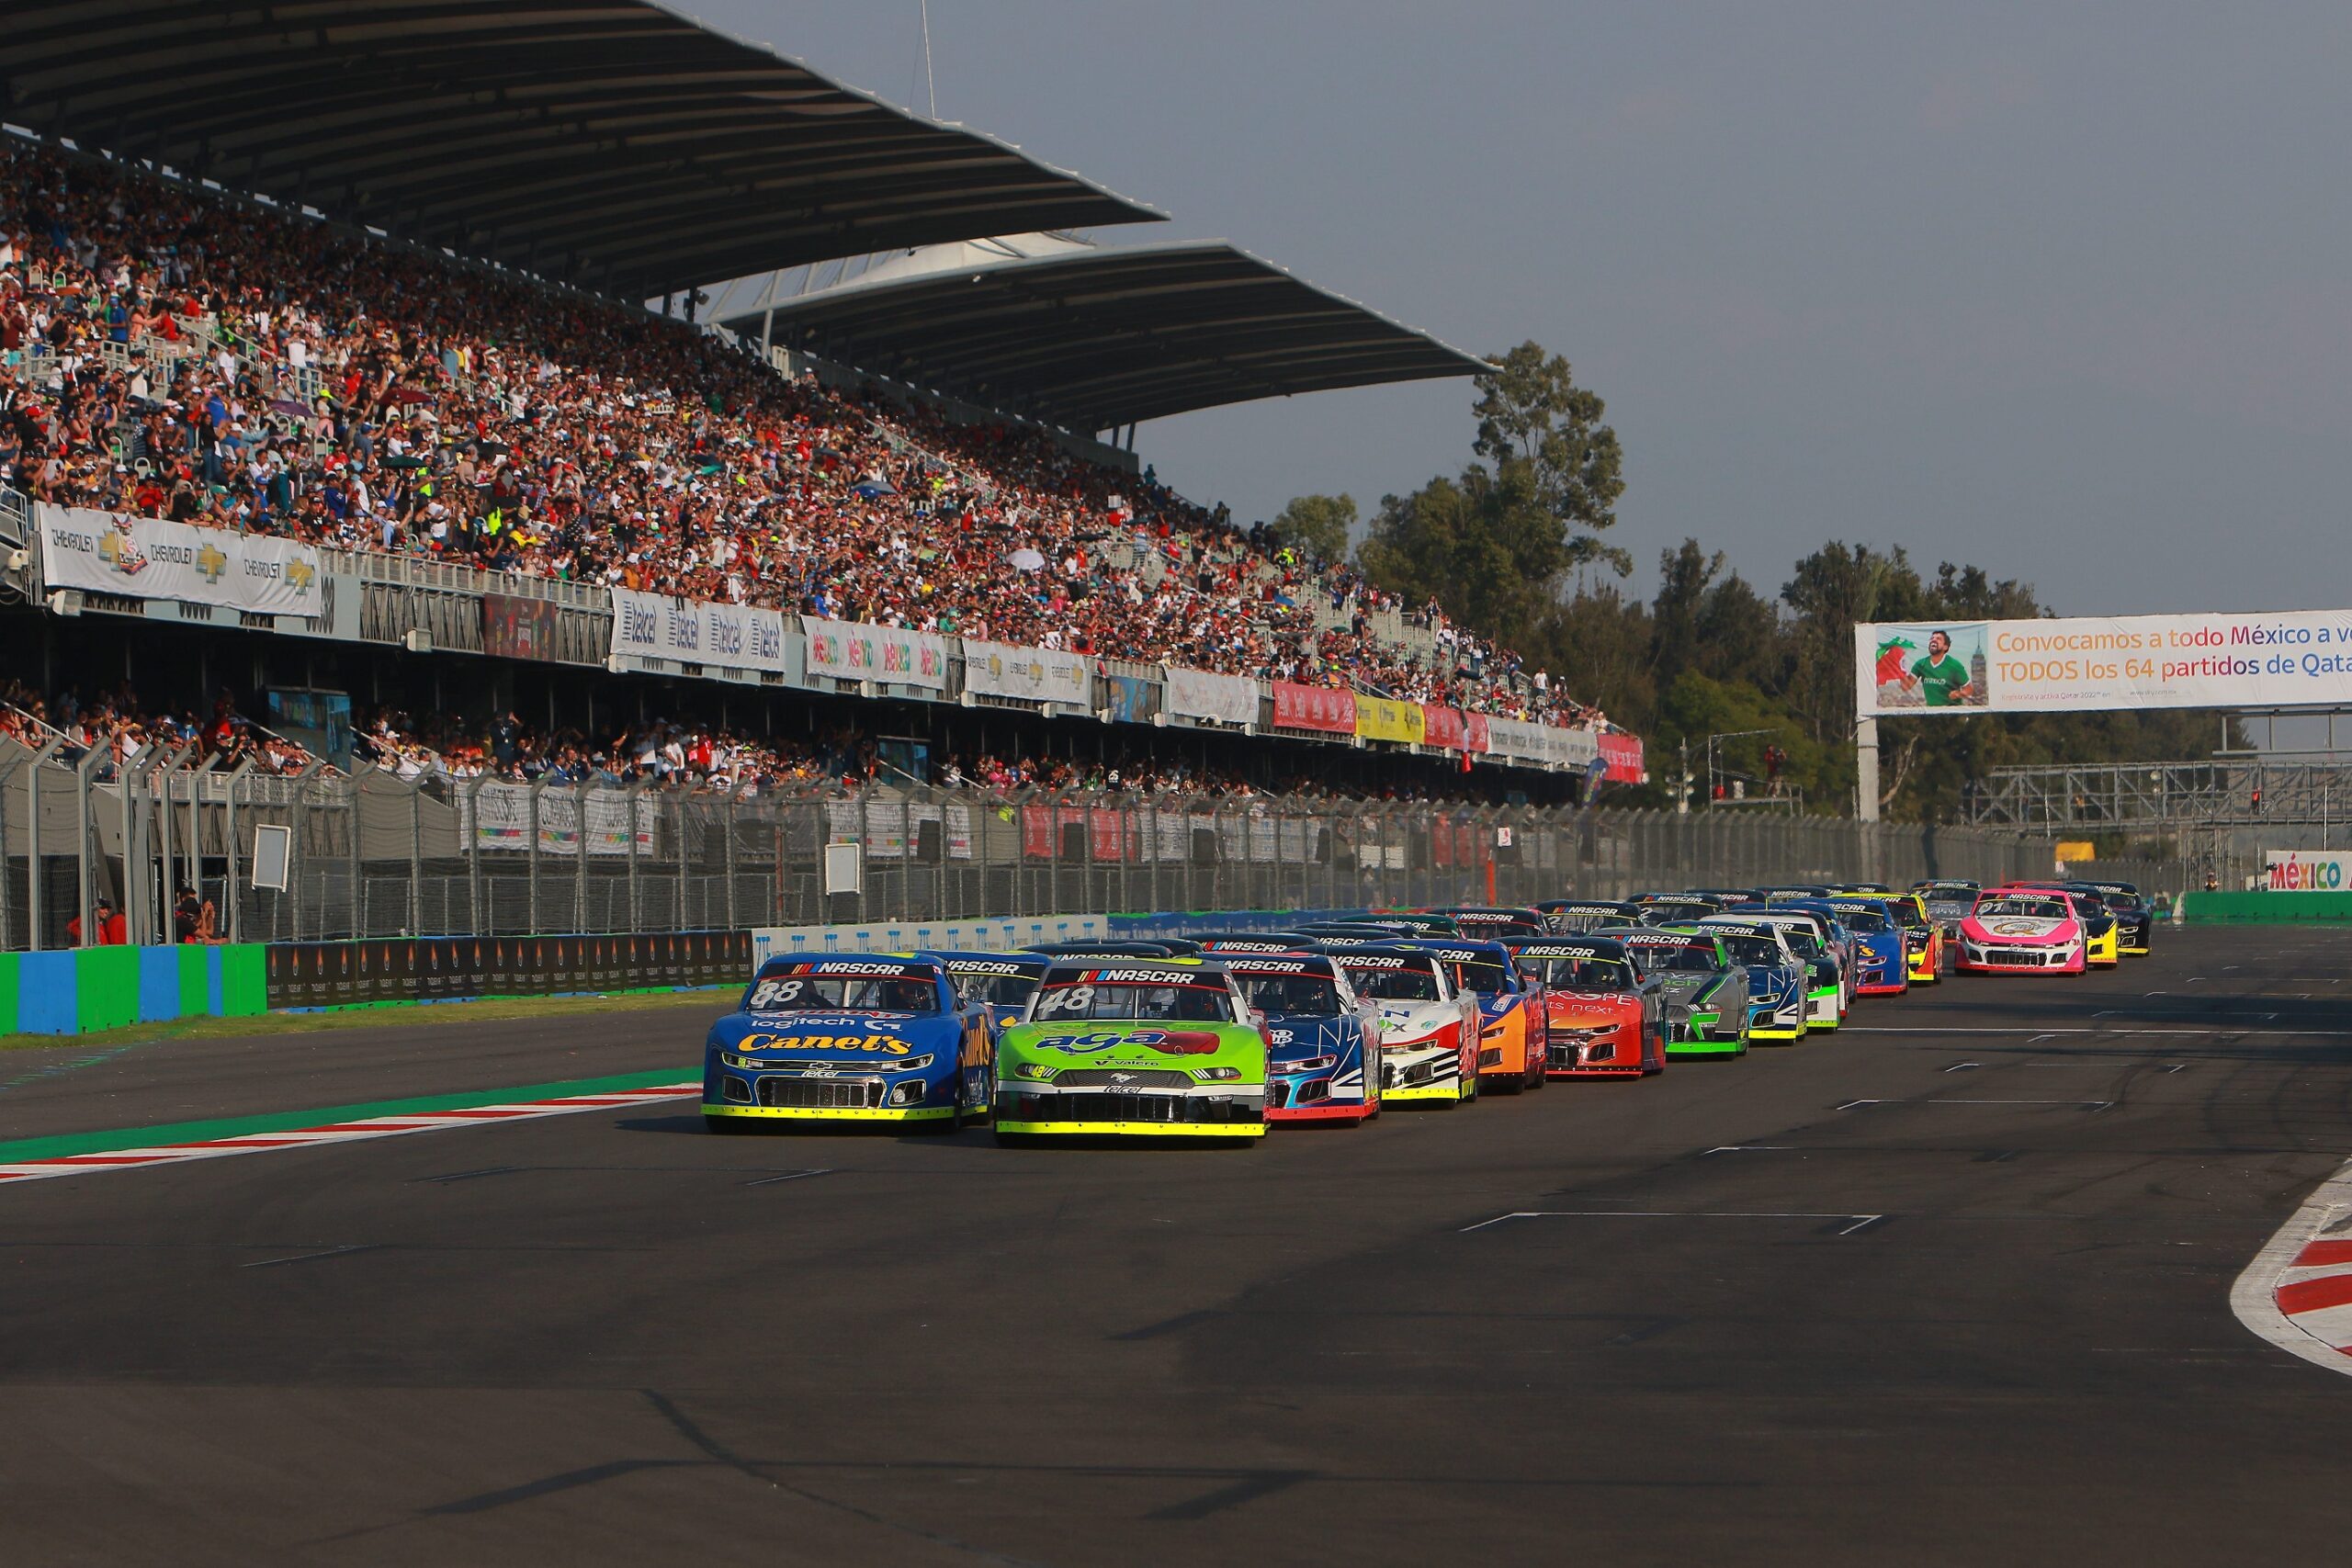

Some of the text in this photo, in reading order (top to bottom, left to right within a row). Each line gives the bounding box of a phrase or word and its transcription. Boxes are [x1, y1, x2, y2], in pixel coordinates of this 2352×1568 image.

[52, 528, 95, 553] CHEVROLET
[150, 544, 192, 565] CHEVROLET
[243, 558, 281, 579] CHEVROLET
[631, 602, 657, 645] telcel
[676, 610, 699, 651] telcel
[718, 614, 741, 654] telcel
[1996, 630, 2143, 654] Convocamos
[2148, 632, 2163, 648] a
[2169, 626, 2224, 649] todo
[2230, 624, 2311, 647] México
[2317, 626, 2332, 643] a
[1996, 660, 2079, 682] TODOS
[2086, 659, 2118, 681] los
[2124, 658, 2155, 680] 64
[2161, 656, 2261, 683] partidos
[2266, 653, 2295, 674] de
[1716, 893, 1749, 901] SCAR
[2009, 893, 2052, 901] NASCAR
[1459, 913, 1514, 922] NASCAR
[1568, 906, 1619, 916] NASCAR
[1627, 934, 1691, 946] NASCAR
[1219, 942, 1288, 953] NASCAR
[1524, 945, 1596, 957] NASCAR
[1435, 949, 1476, 962] CAR
[818, 962, 905, 976] NASCAR
[1223, 960, 1306, 973] NASCAR
[1104, 969, 1195, 984] NASCAR
[750, 979, 804, 1009] 88
[1039, 987, 1096, 1013] 48
[752, 1016, 855, 1030] logitech
[738, 1032, 913, 1055] Canel's
[1035, 1030, 1168, 1055] aga
[1114, 1059, 1160, 1067] Valero
[801, 1069, 839, 1078] telcel
[1031, 1065, 1046, 1078] 48
[1103, 1084, 1144, 1095] telcel
